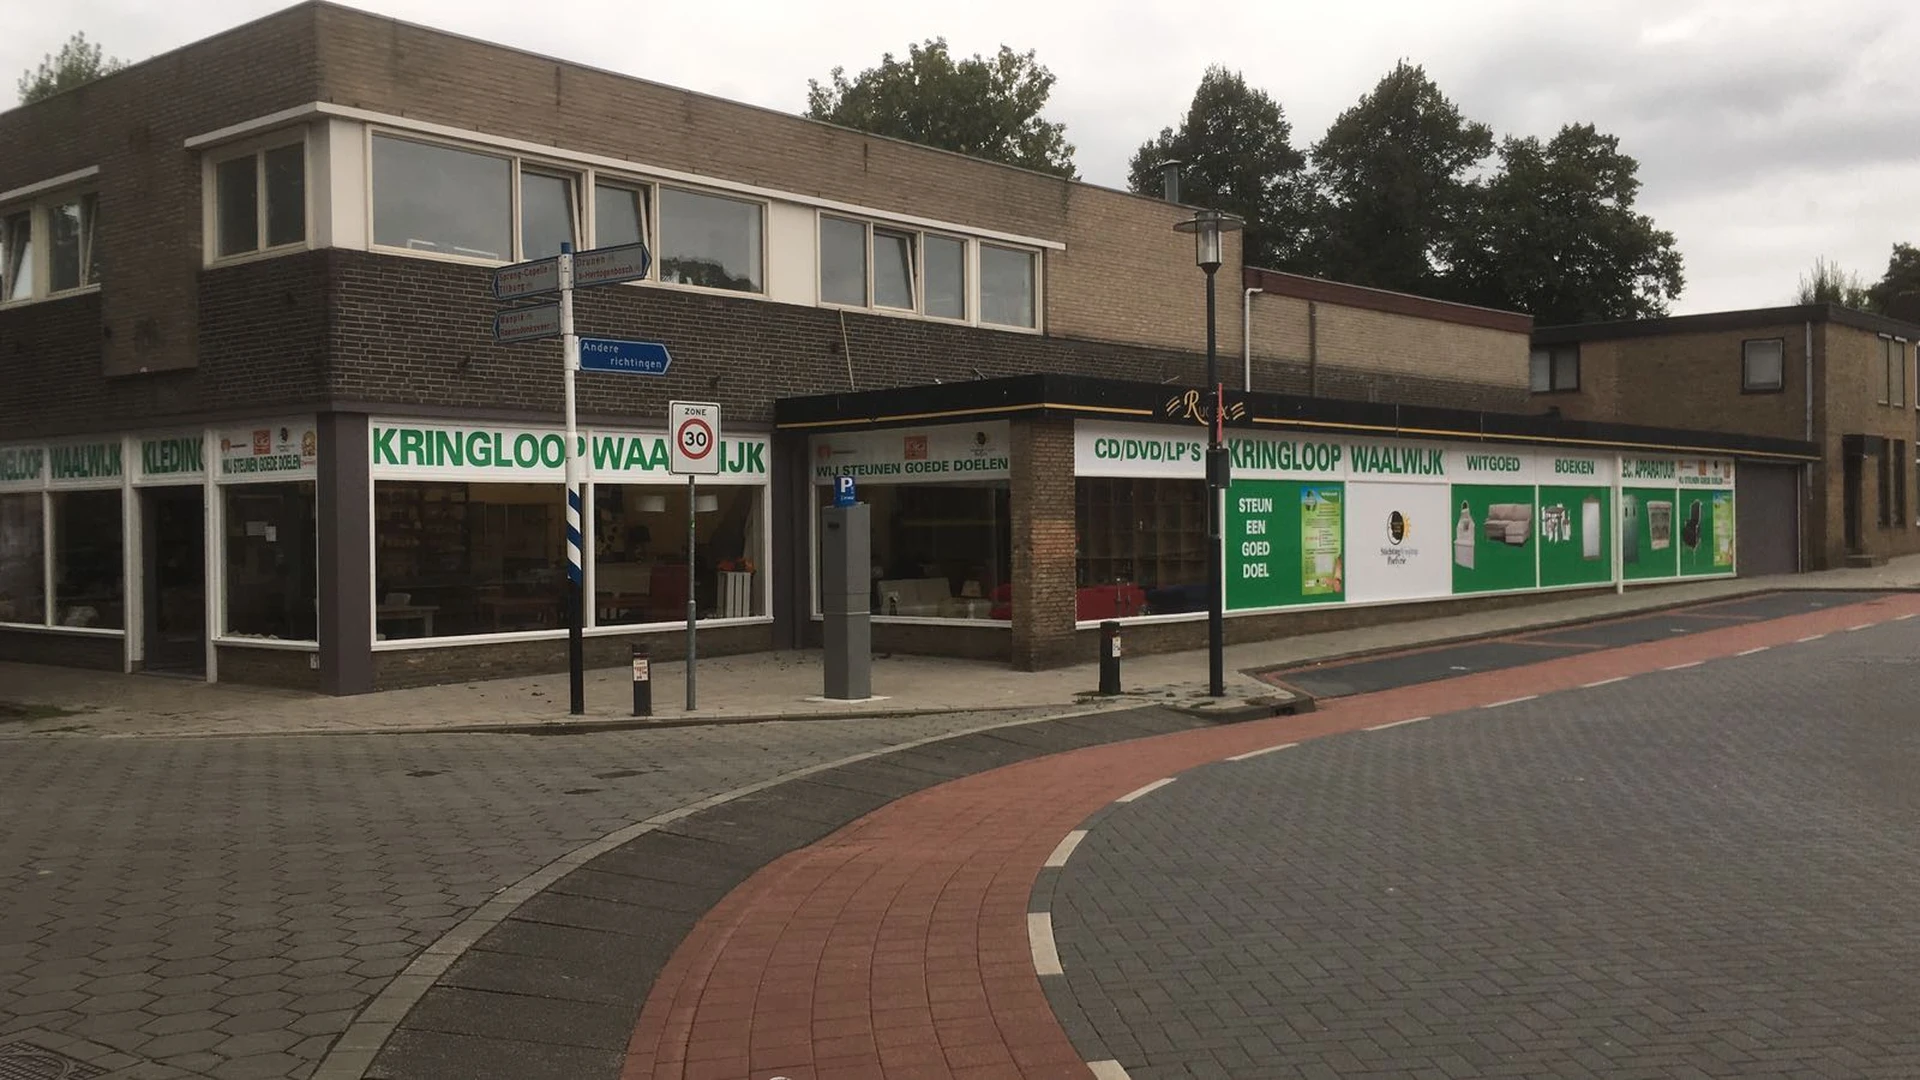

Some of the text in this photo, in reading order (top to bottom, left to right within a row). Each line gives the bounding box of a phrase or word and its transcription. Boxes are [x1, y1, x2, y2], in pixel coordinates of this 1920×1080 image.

[582, 342, 619, 354] Andere
[610, 357, 662, 369] richtingen
[684, 407, 707, 416] ZONE
[684, 431, 707, 447] 30
[593, 436, 765, 473] WAAIJK
[1094, 438, 1201, 463] CD/DVD/LP'S
[1228, 438, 1444, 475] KRINGLOOP WAALWIJK
[50, 443, 122, 479] WAALWIJK
[816, 457, 1008, 478] WIJ STEUNEN GOEDE DOELEN
[1466, 455, 1520, 472] WITGOED
[1554, 459, 1594, 475] BOEKEN
[840, 477, 853, 493] P
[1238, 497, 1272, 513] STEUN
[1246, 519, 1266, 535] EEN
[1241, 541, 1270, 556] GOED
[1243, 563, 1269, 578] DOEL
